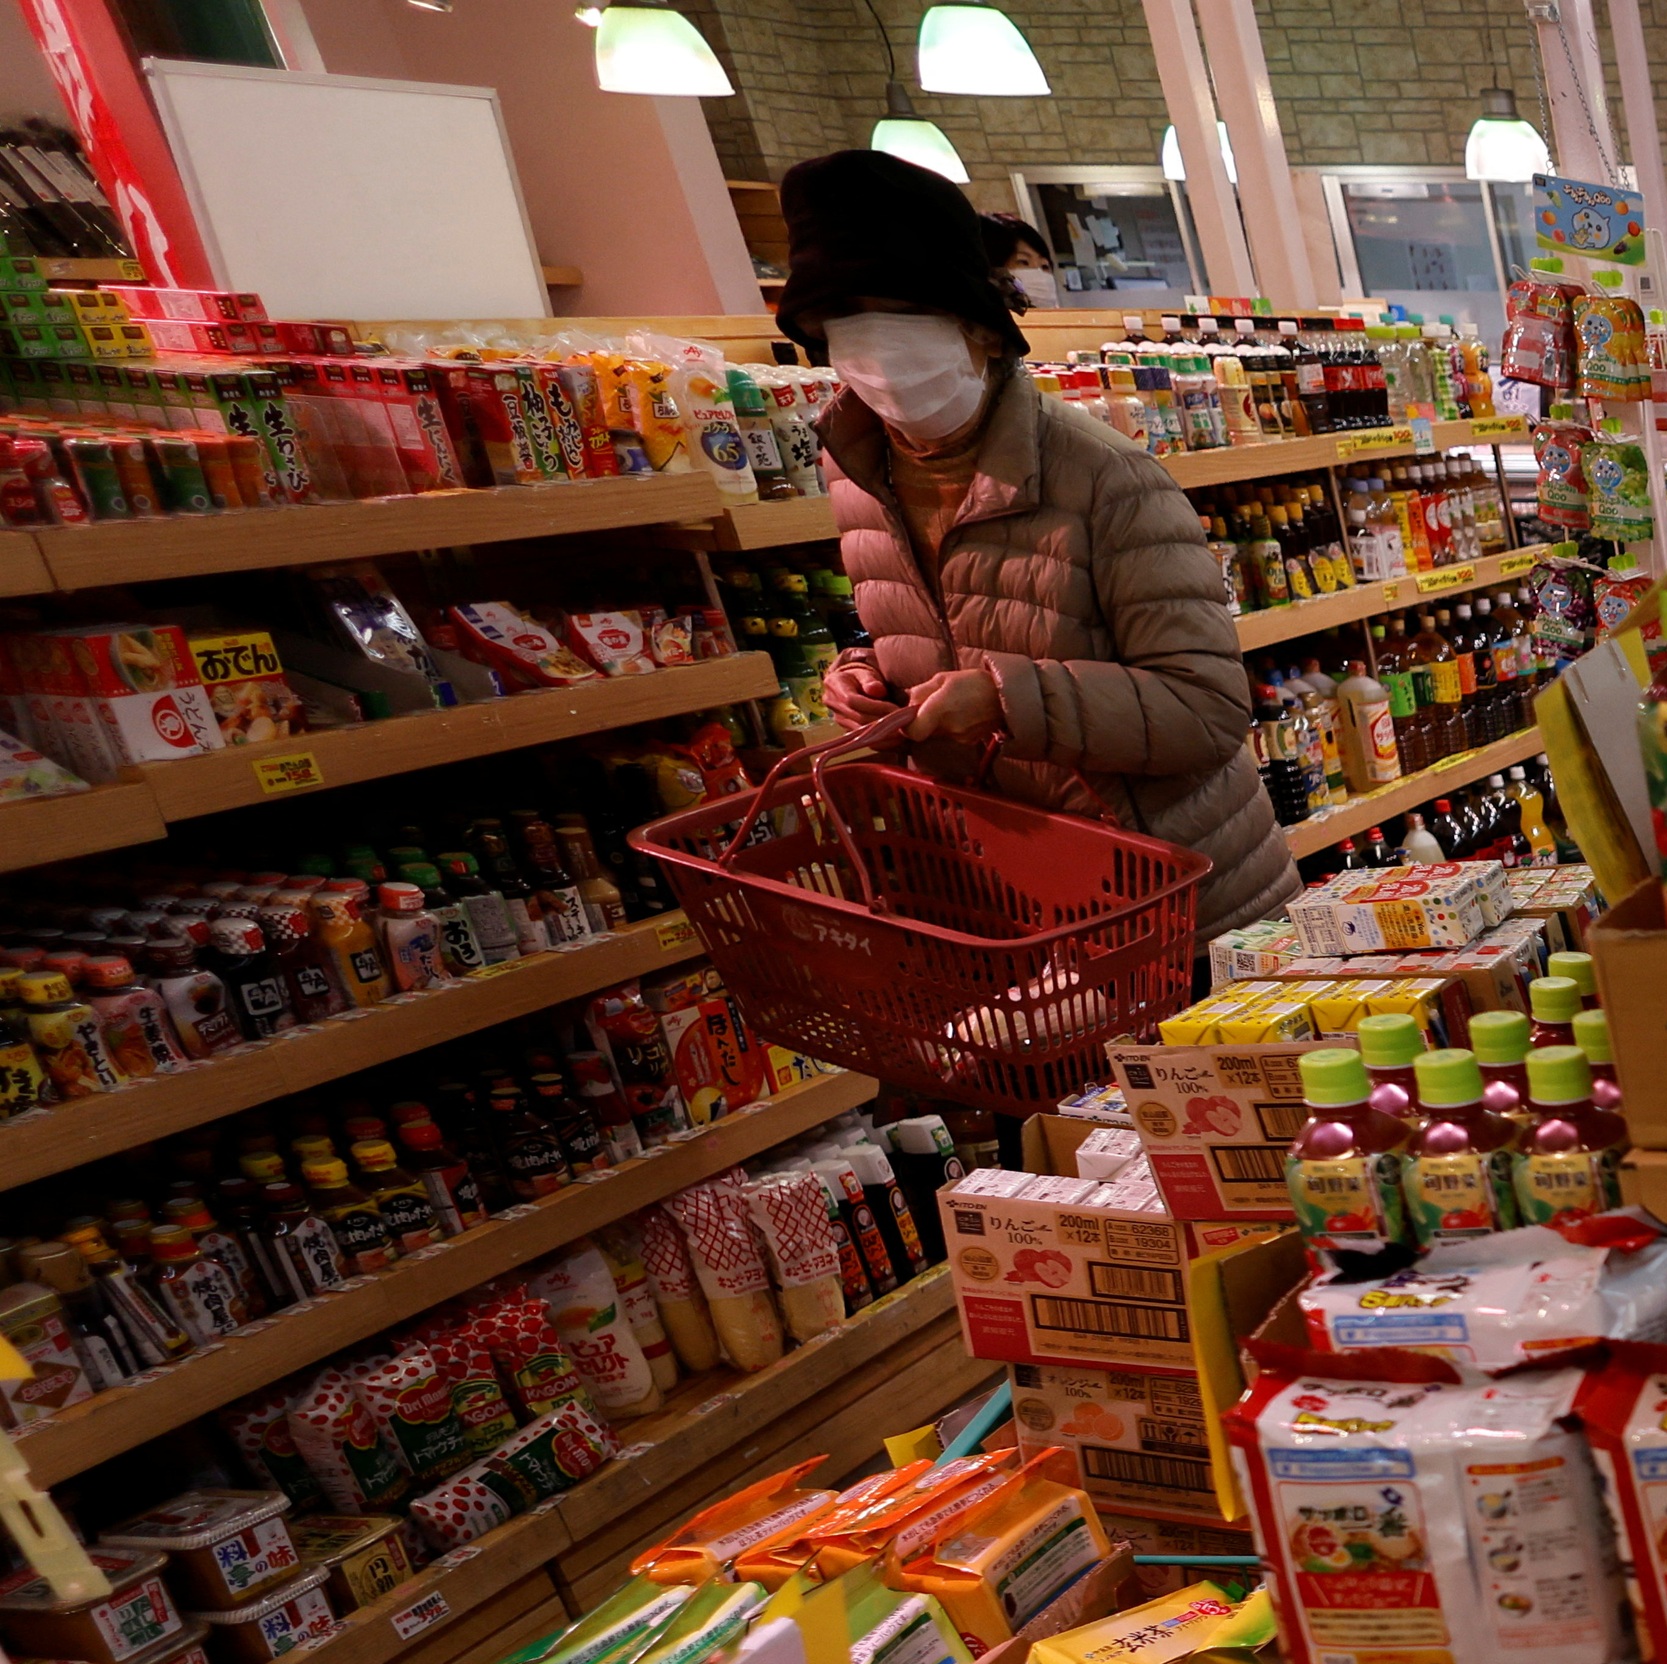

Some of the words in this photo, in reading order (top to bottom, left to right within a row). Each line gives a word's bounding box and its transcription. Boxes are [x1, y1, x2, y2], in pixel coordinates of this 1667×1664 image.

[714, 443, 741, 462] 65
[201, 646, 278, 682] おでん
[706, 1012, 742, 1087] ほんだし
[1217, 1056, 1257, 1070] 200ml
[1155, 1067, 1200, 1081] りんご
[1227, 1070, 1262, 1084] ×12本
[1176, 1082, 1208, 1095] 100%
[990, 1216, 1035, 1232] りんご
[1059, 1214, 1099, 1231] 200ml
[1066, 1230, 1101, 1244] ×12本
[1131, 1225, 1170, 1237] 62368
[1007, 1232, 1043, 1246] 100%
[1134, 1237, 1171, 1249] 19304
[569, 1334, 616, 1358] ピュア
[574, 1354, 630, 1377] セレクト
[1110, 1372, 1145, 1388] 200ml
[525, 1376, 580, 1402] KAGOM
[1065, 1387, 1092, 1398] 100%
